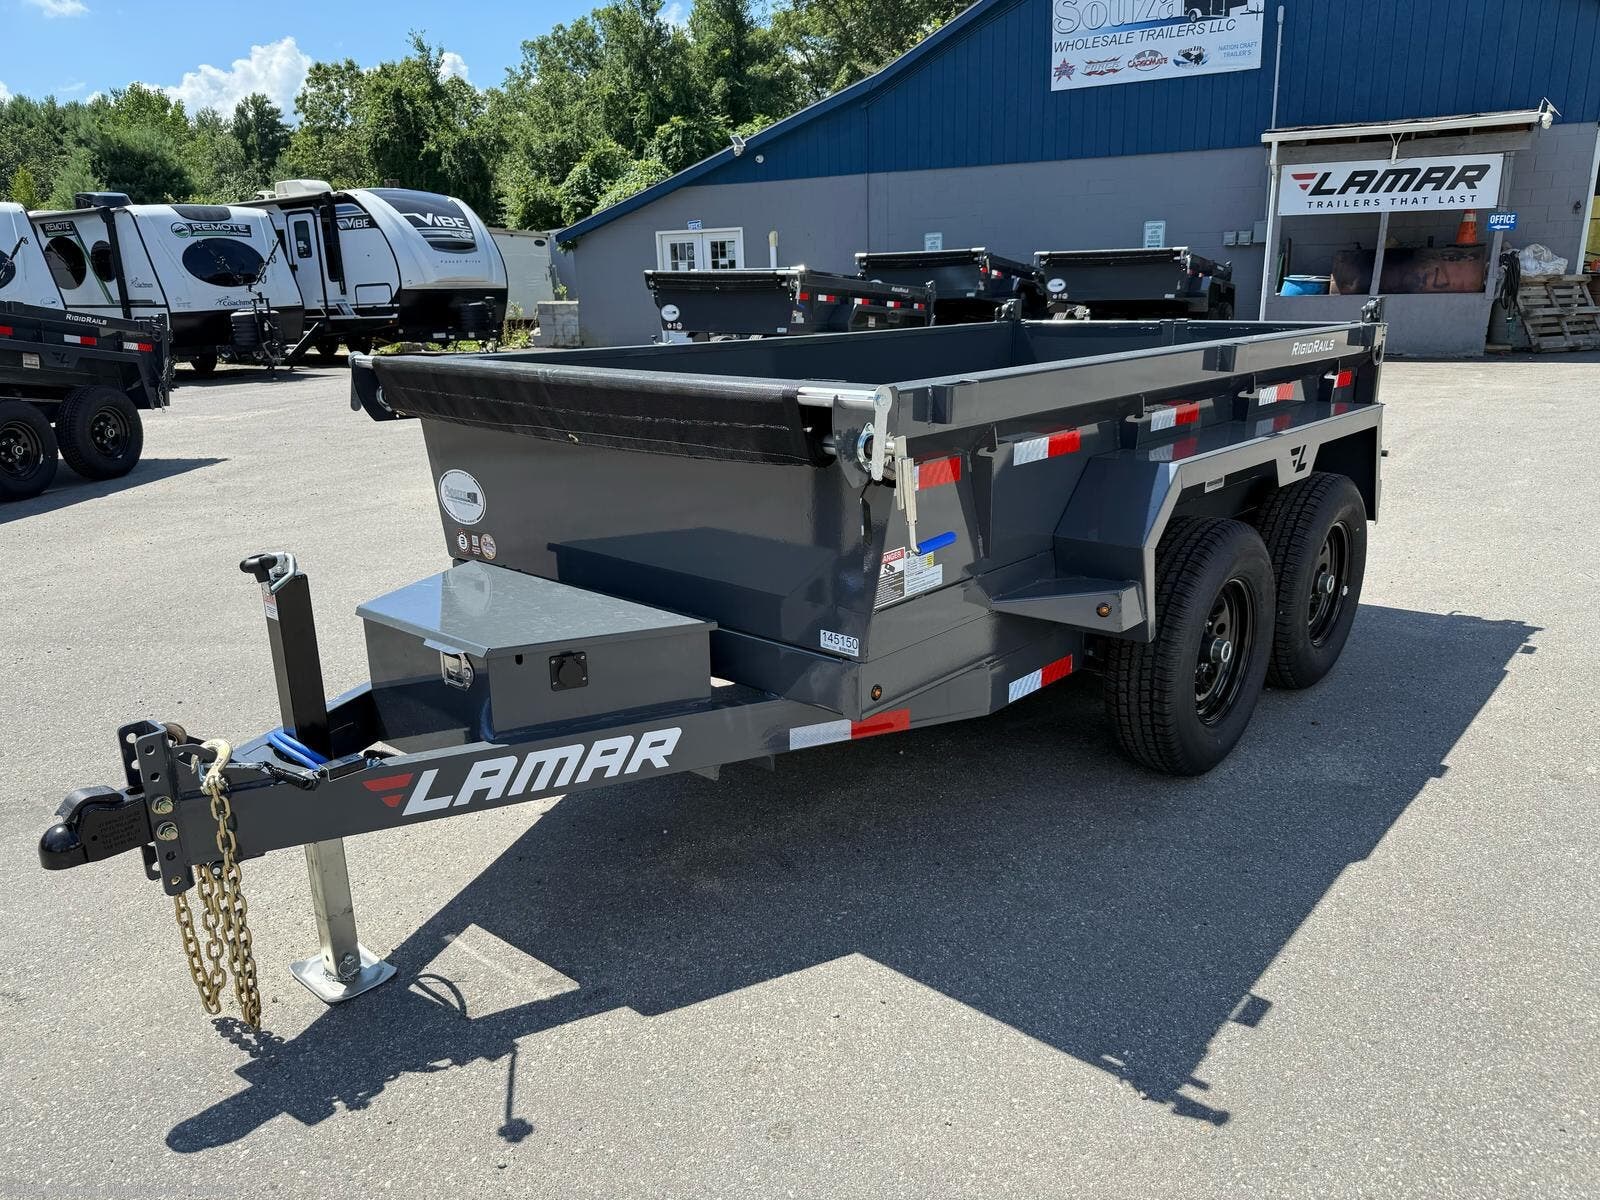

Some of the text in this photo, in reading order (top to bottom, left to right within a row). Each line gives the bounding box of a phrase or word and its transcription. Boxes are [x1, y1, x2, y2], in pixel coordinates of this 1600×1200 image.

[1054, 18, 1237, 53] WHOLESALE TRAILERS LLC
[1239, 41, 1258, 49] CRAFT
[1308, 163, 1491, 196] LAMAR
[1307, 194, 1477, 209] TRAILERS THAT LAST
[344, 217, 370, 228] VIBE
[402, 212, 471, 229] VIBE
[1490, 214, 1516, 224] OFFICE
[45, 222, 71, 232] REMOTE
[191, 223, 248, 232] REMOTE
[822, 631, 858, 650] 145150
[402, 727, 682, 816] LAMAR
